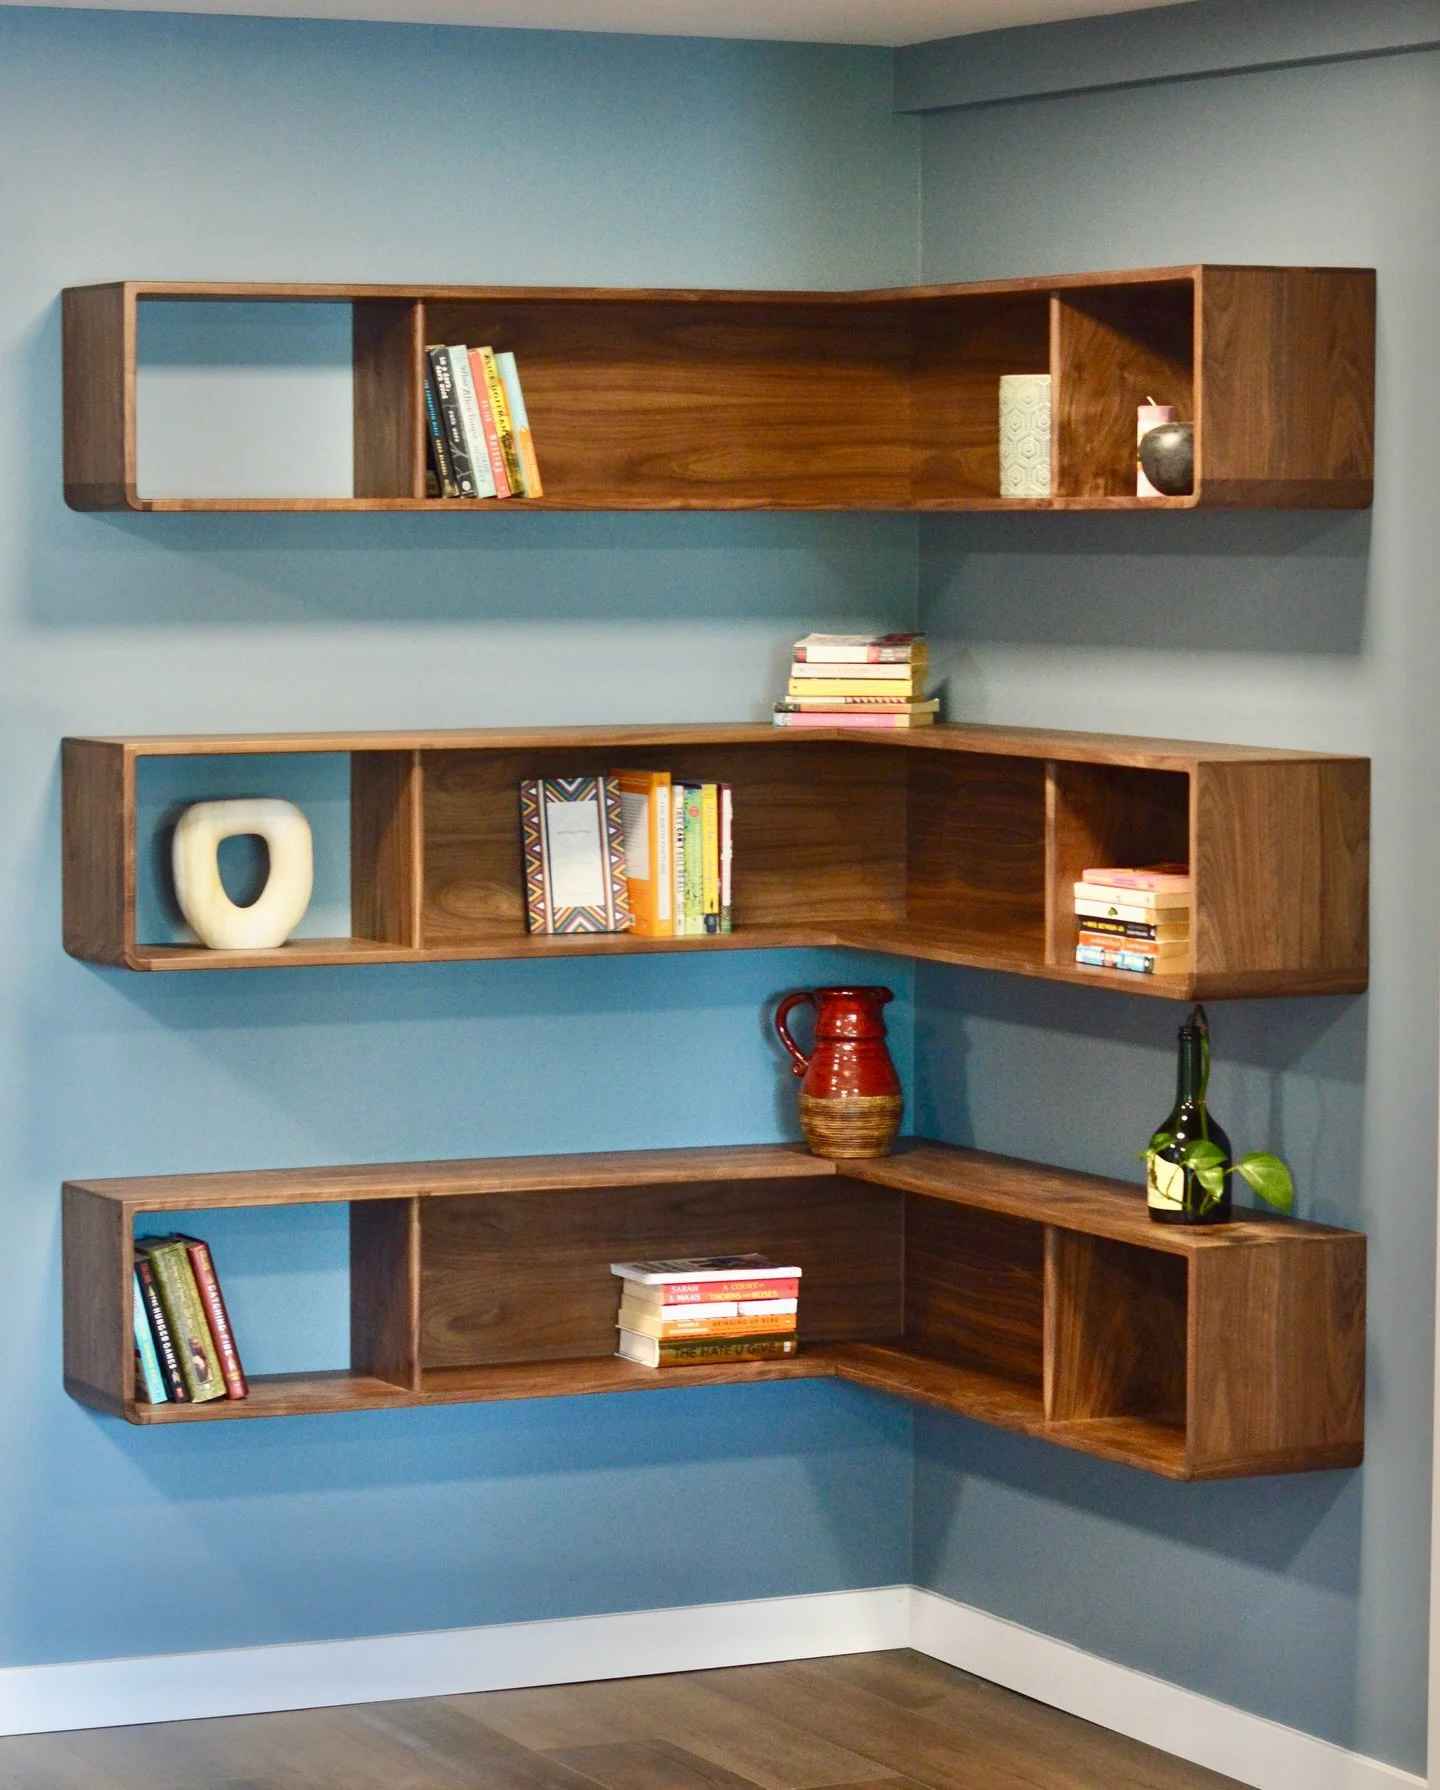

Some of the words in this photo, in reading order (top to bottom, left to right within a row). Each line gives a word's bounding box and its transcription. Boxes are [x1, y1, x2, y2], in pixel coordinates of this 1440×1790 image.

[670, 1285, 699, 1293] SARAH
[208, 1284, 227, 1332] CATCHING
[675, 1348, 696, 1358] THE
[700, 1346, 730, 1357] HATE
